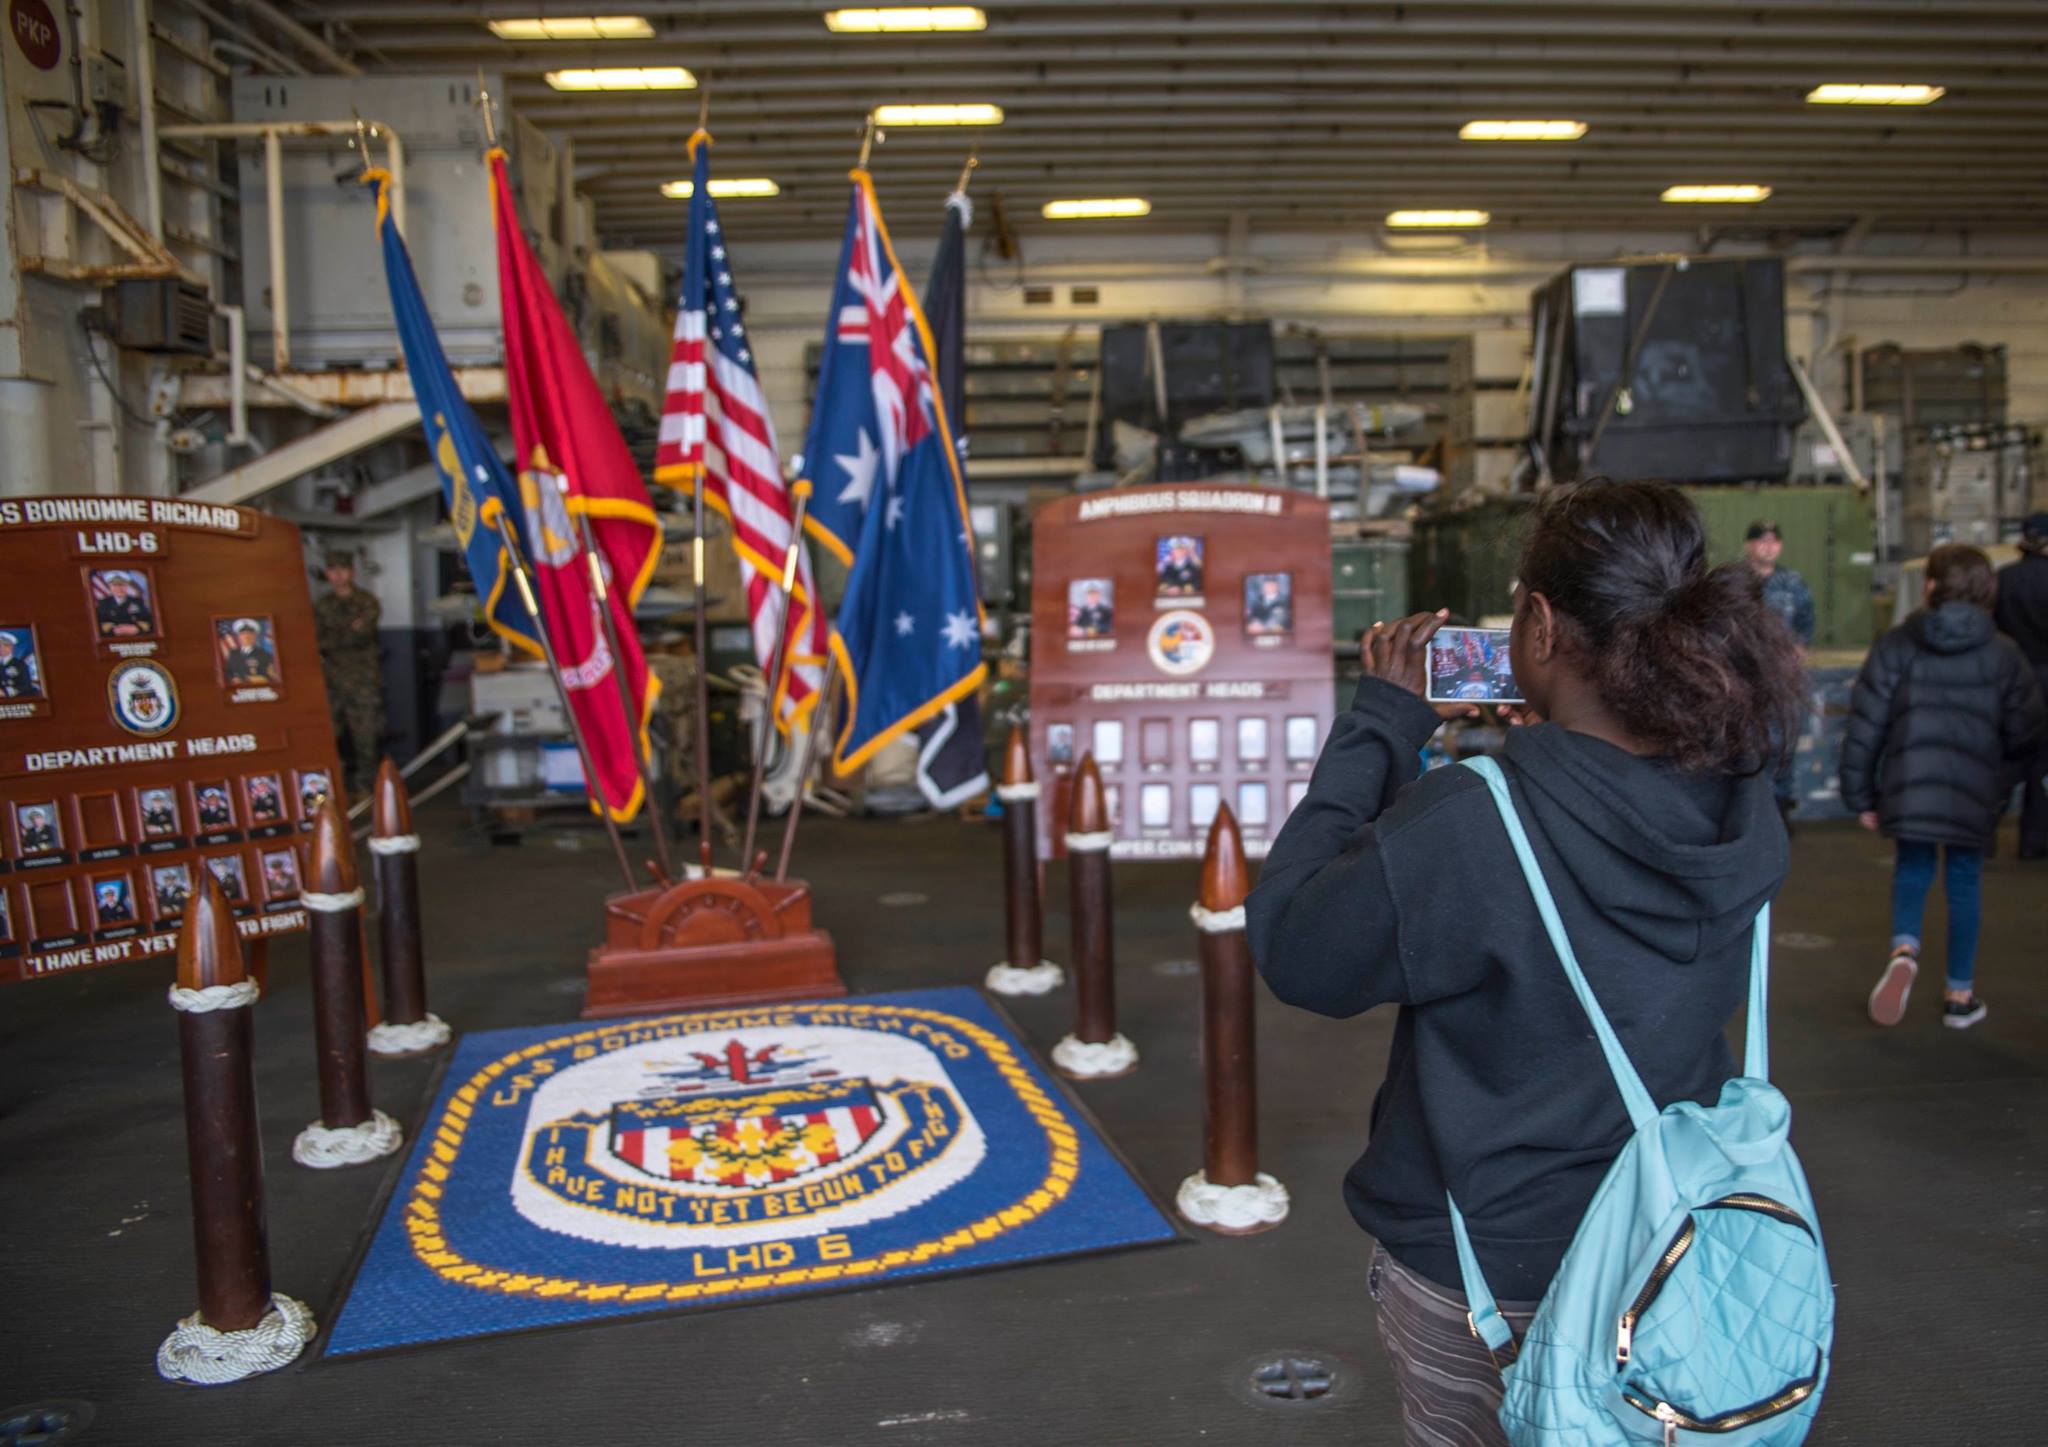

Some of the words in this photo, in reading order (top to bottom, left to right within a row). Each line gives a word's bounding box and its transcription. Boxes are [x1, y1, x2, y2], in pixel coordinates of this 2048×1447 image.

[17, 10, 51, 48] PKP
[24, 499, 149, 523] BONHOMME
[151, 501, 240, 531] RICHARD
[1079, 491, 1175, 520] AMPHIBIOUS
[1176, 490, 1265, 513] SQUADRON
[77, 531, 158, 553] LHD-6
[1092, 683, 1201, 700] DEPARTMENT
[1206, 682, 1263, 698] HEADS
[26, 741, 177, 771] DEPARTMENT
[187, 734, 257, 757] HEADS
[46, 947, 93, 970] HAVE
[95, 941, 132, 962] NOT
[139, 933, 178, 955] YET
[236, 919, 259, 936] TO
[260, 910, 306, 933] FIGHT
[492, 1058, 556, 1106] USS
[573, 1012, 796, 1060] BONHOMME
[810, 1013, 970, 1059] RICHARD
[545, 1146, 605, 1201] HAVE
[616, 1186, 677, 1218] NOT
[690, 1198, 750, 1223] YET
[763, 1173, 865, 1217] BEGUN
[869, 1152, 907, 1184] TO
[908, 1086, 949, 1159] FIGHT
[693, 1241, 796, 1277] LHD
[816, 1233, 852, 1260] 6
